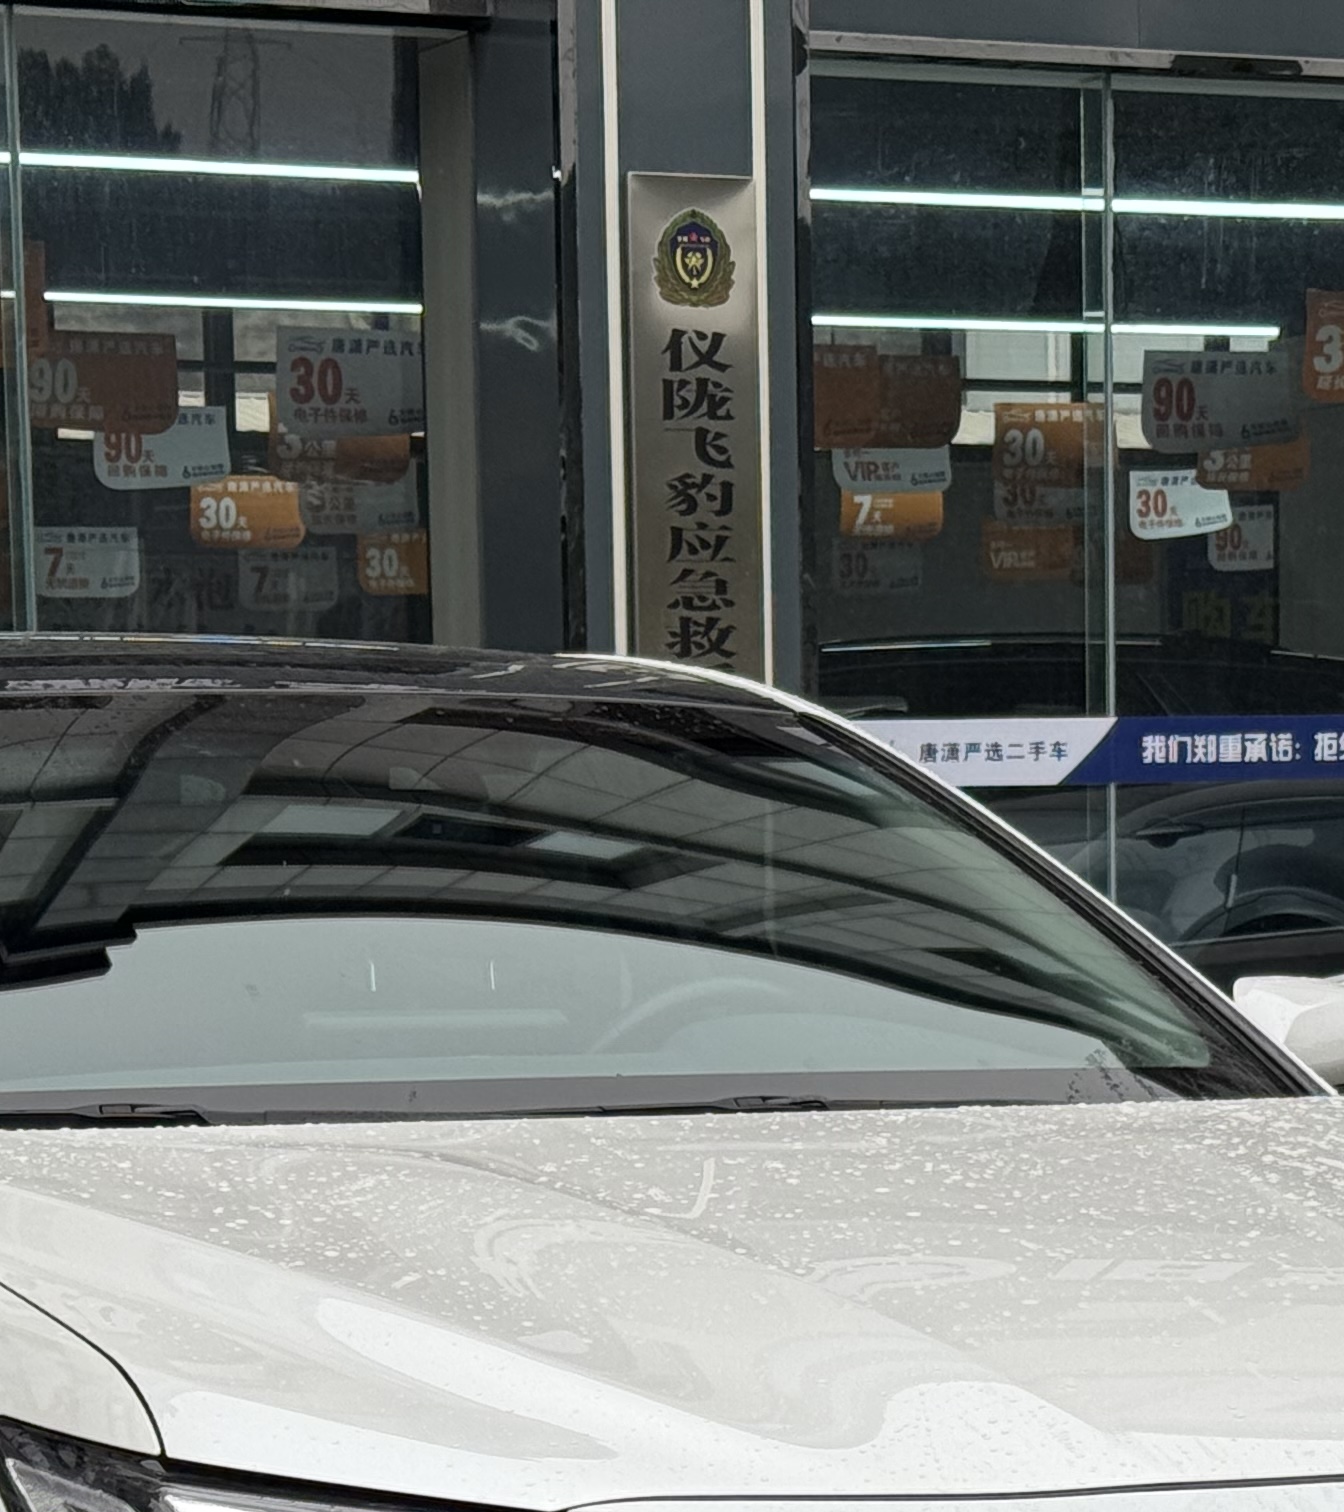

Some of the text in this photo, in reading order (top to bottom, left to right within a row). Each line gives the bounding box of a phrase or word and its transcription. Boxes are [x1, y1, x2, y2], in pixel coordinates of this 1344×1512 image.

[1313, 325, 1344, 373] 3
[843, 461, 879, 481] VIP
[660, 328, 737, 674] 仪陇飞豹应急救
[44, 547, 64, 579] 7
[918, 741, 1069, 763] 唐潇严选二手车
